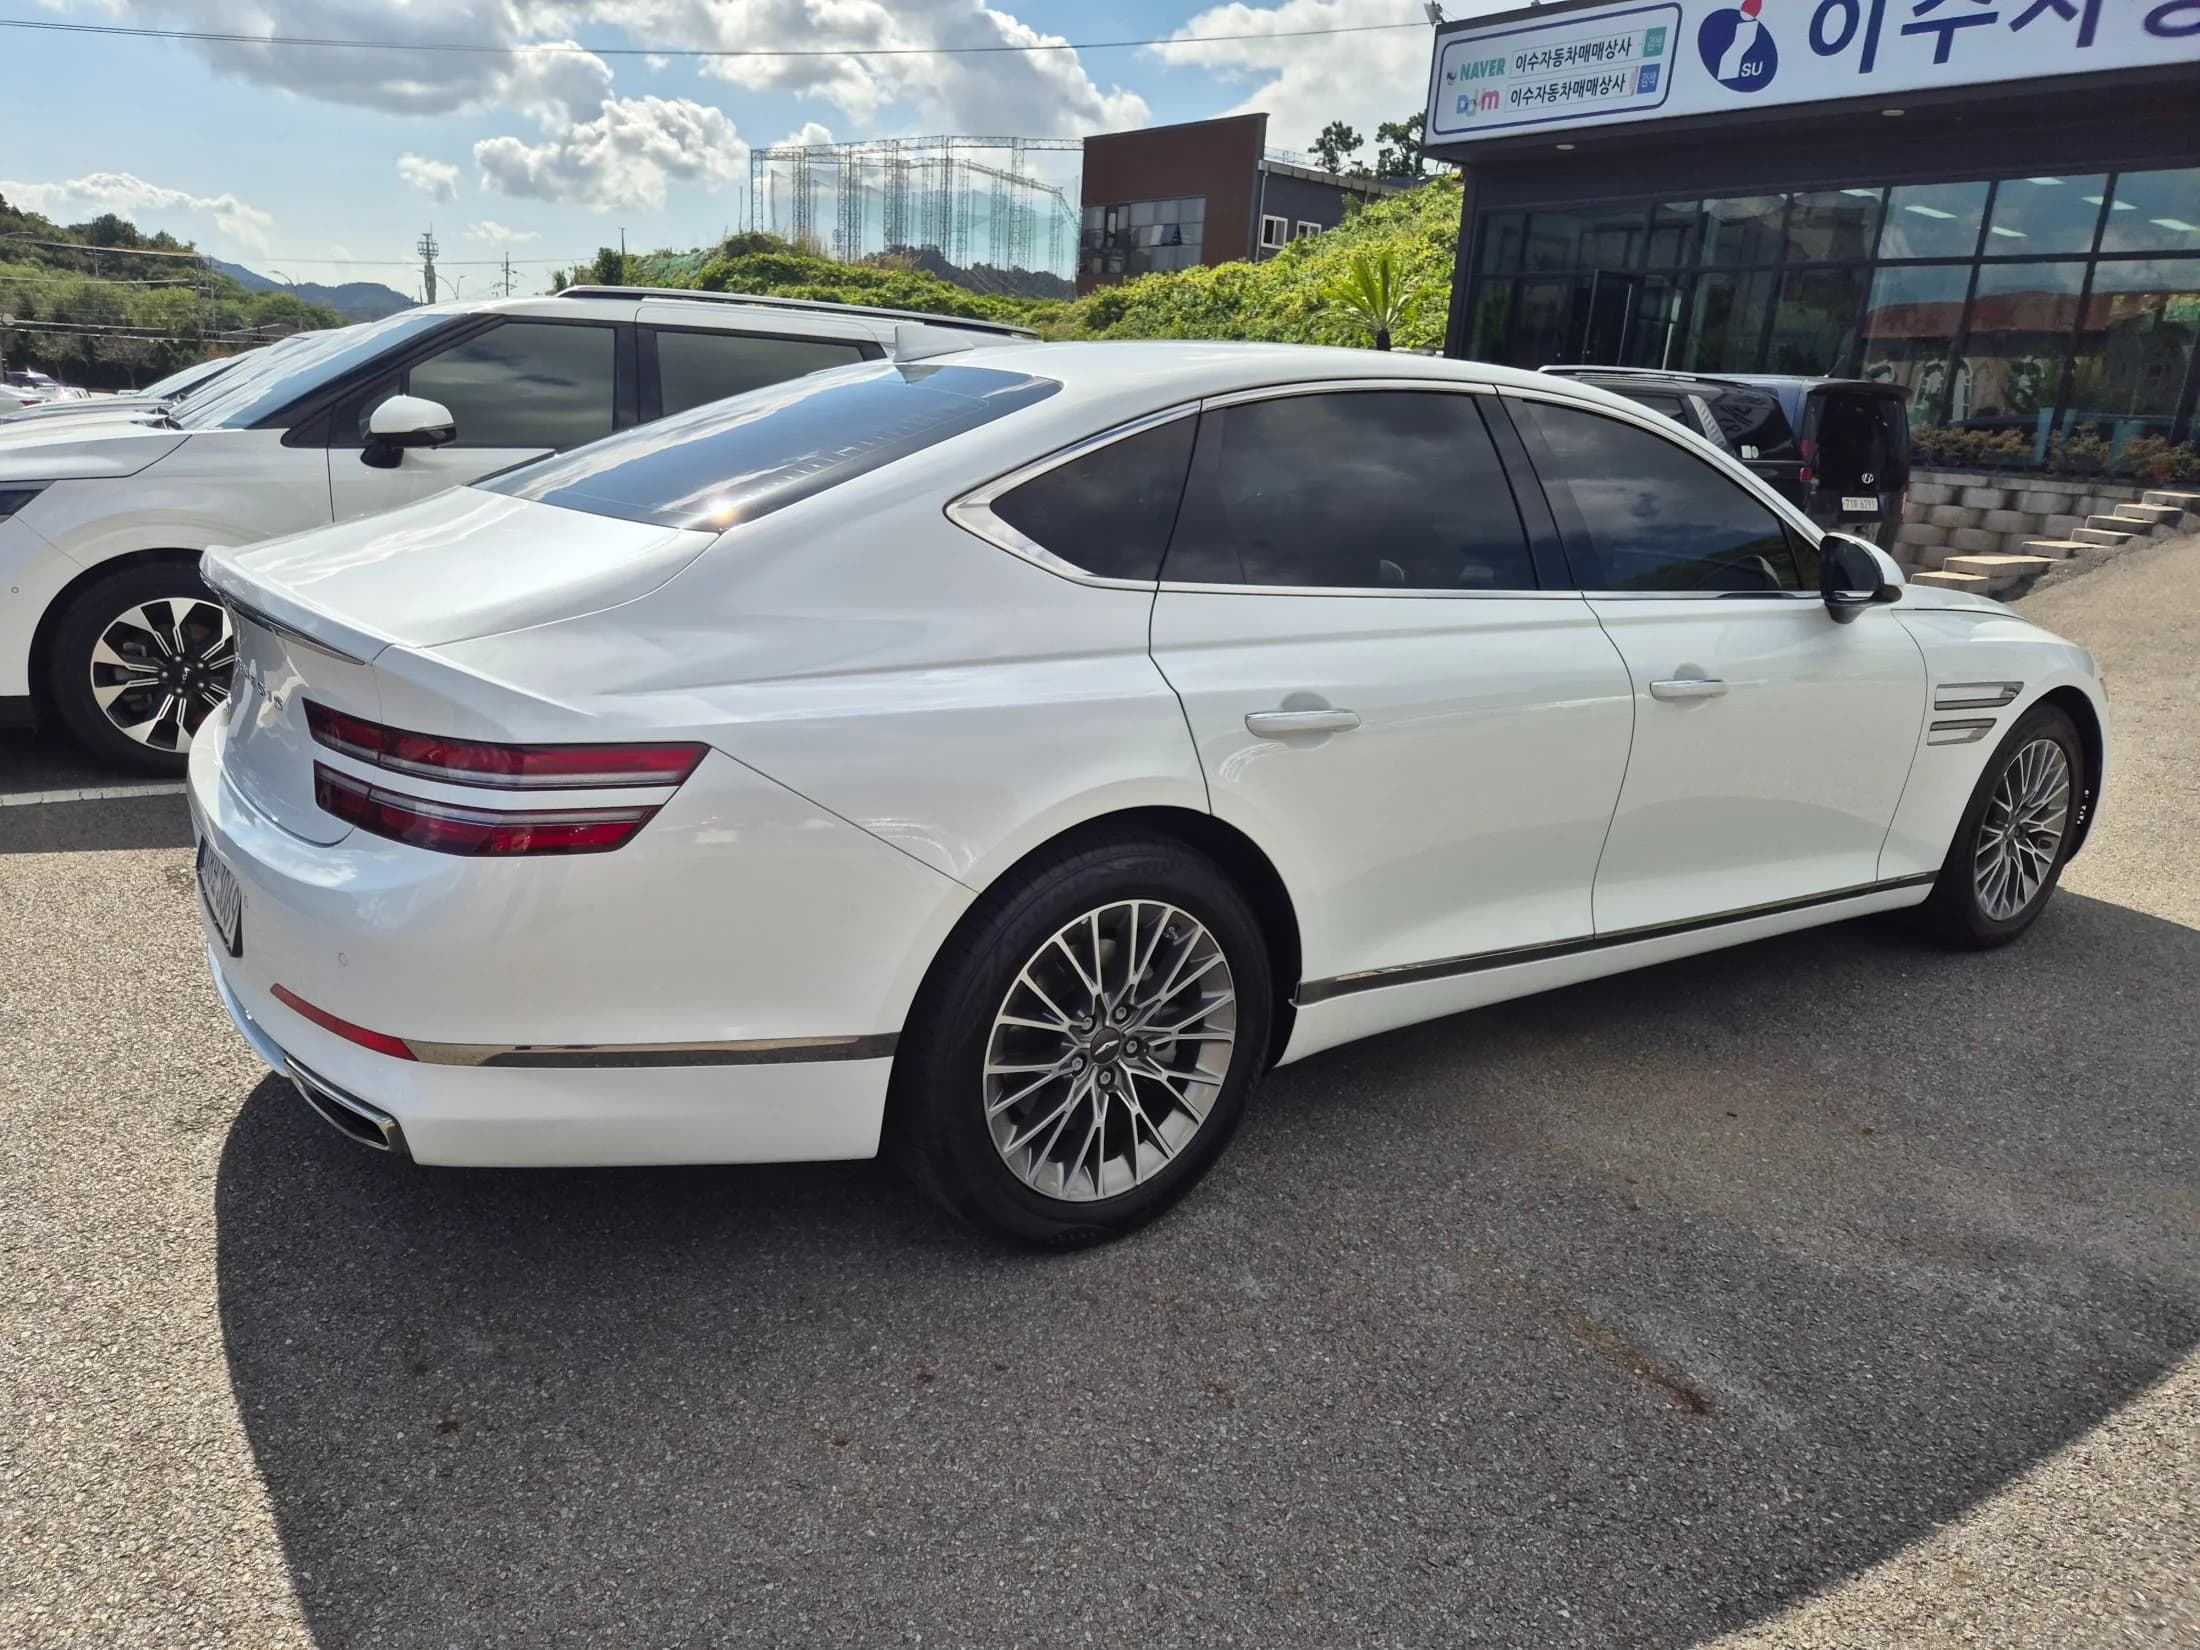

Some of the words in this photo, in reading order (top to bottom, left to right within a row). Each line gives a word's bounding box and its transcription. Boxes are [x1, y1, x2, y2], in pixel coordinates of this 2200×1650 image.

[1515, 37, 1632, 72] 이수자동차매매상사
[1460, 58, 1506, 81] NAVER
[1740, 61, 1764, 77] SU
[1456, 89, 1500, 117] Dam
[1510, 74, 1626, 107] 이수자동차매매상사
